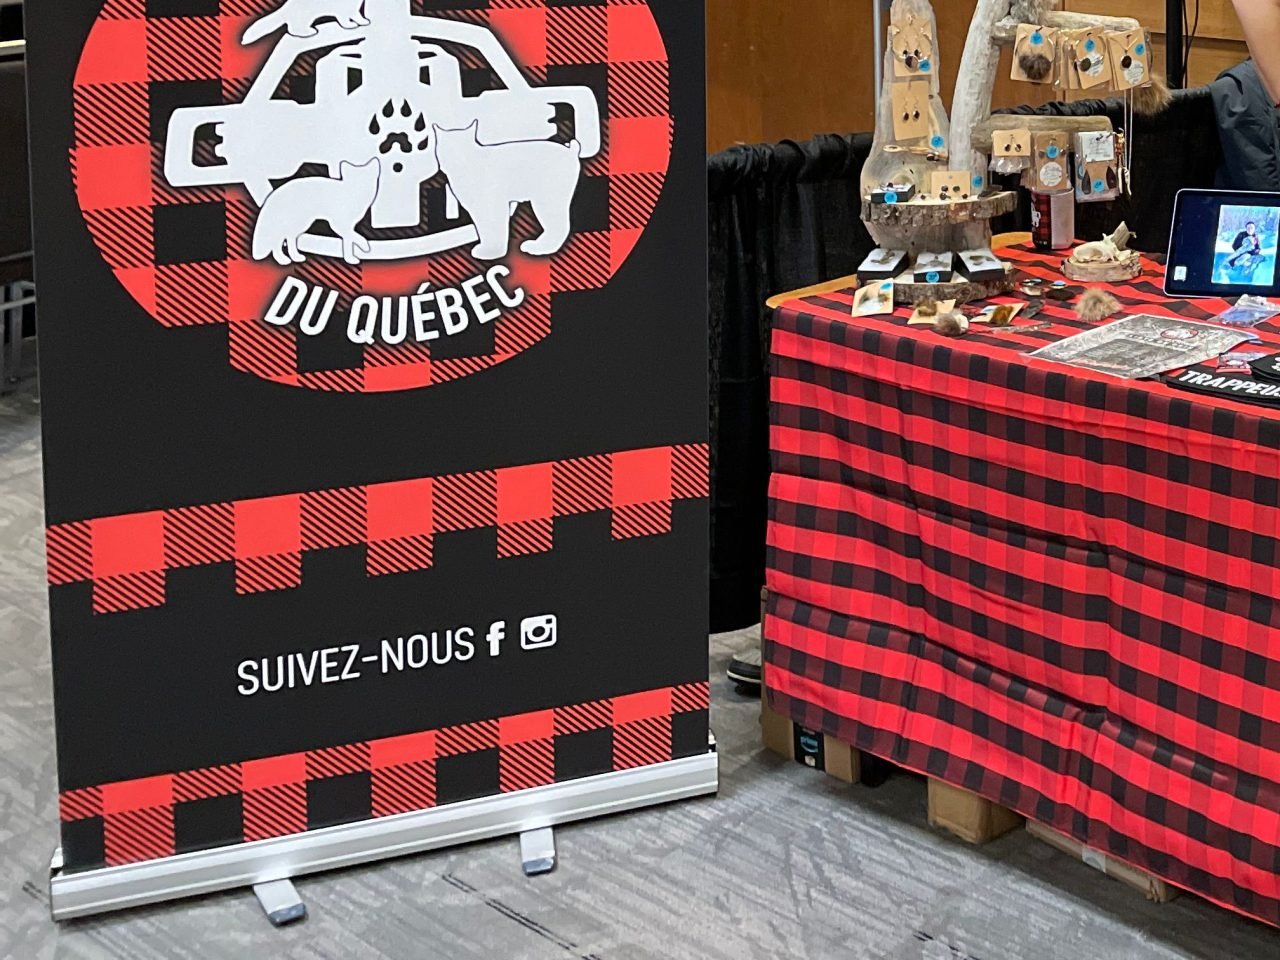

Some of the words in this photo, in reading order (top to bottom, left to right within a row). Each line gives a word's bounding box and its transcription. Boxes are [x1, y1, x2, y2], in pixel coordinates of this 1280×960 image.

[264, 276, 339, 337] DU
[346, 264, 526, 345] QUÉBEC
[237, 626, 475, 696] SUIVEZ-NOUS
